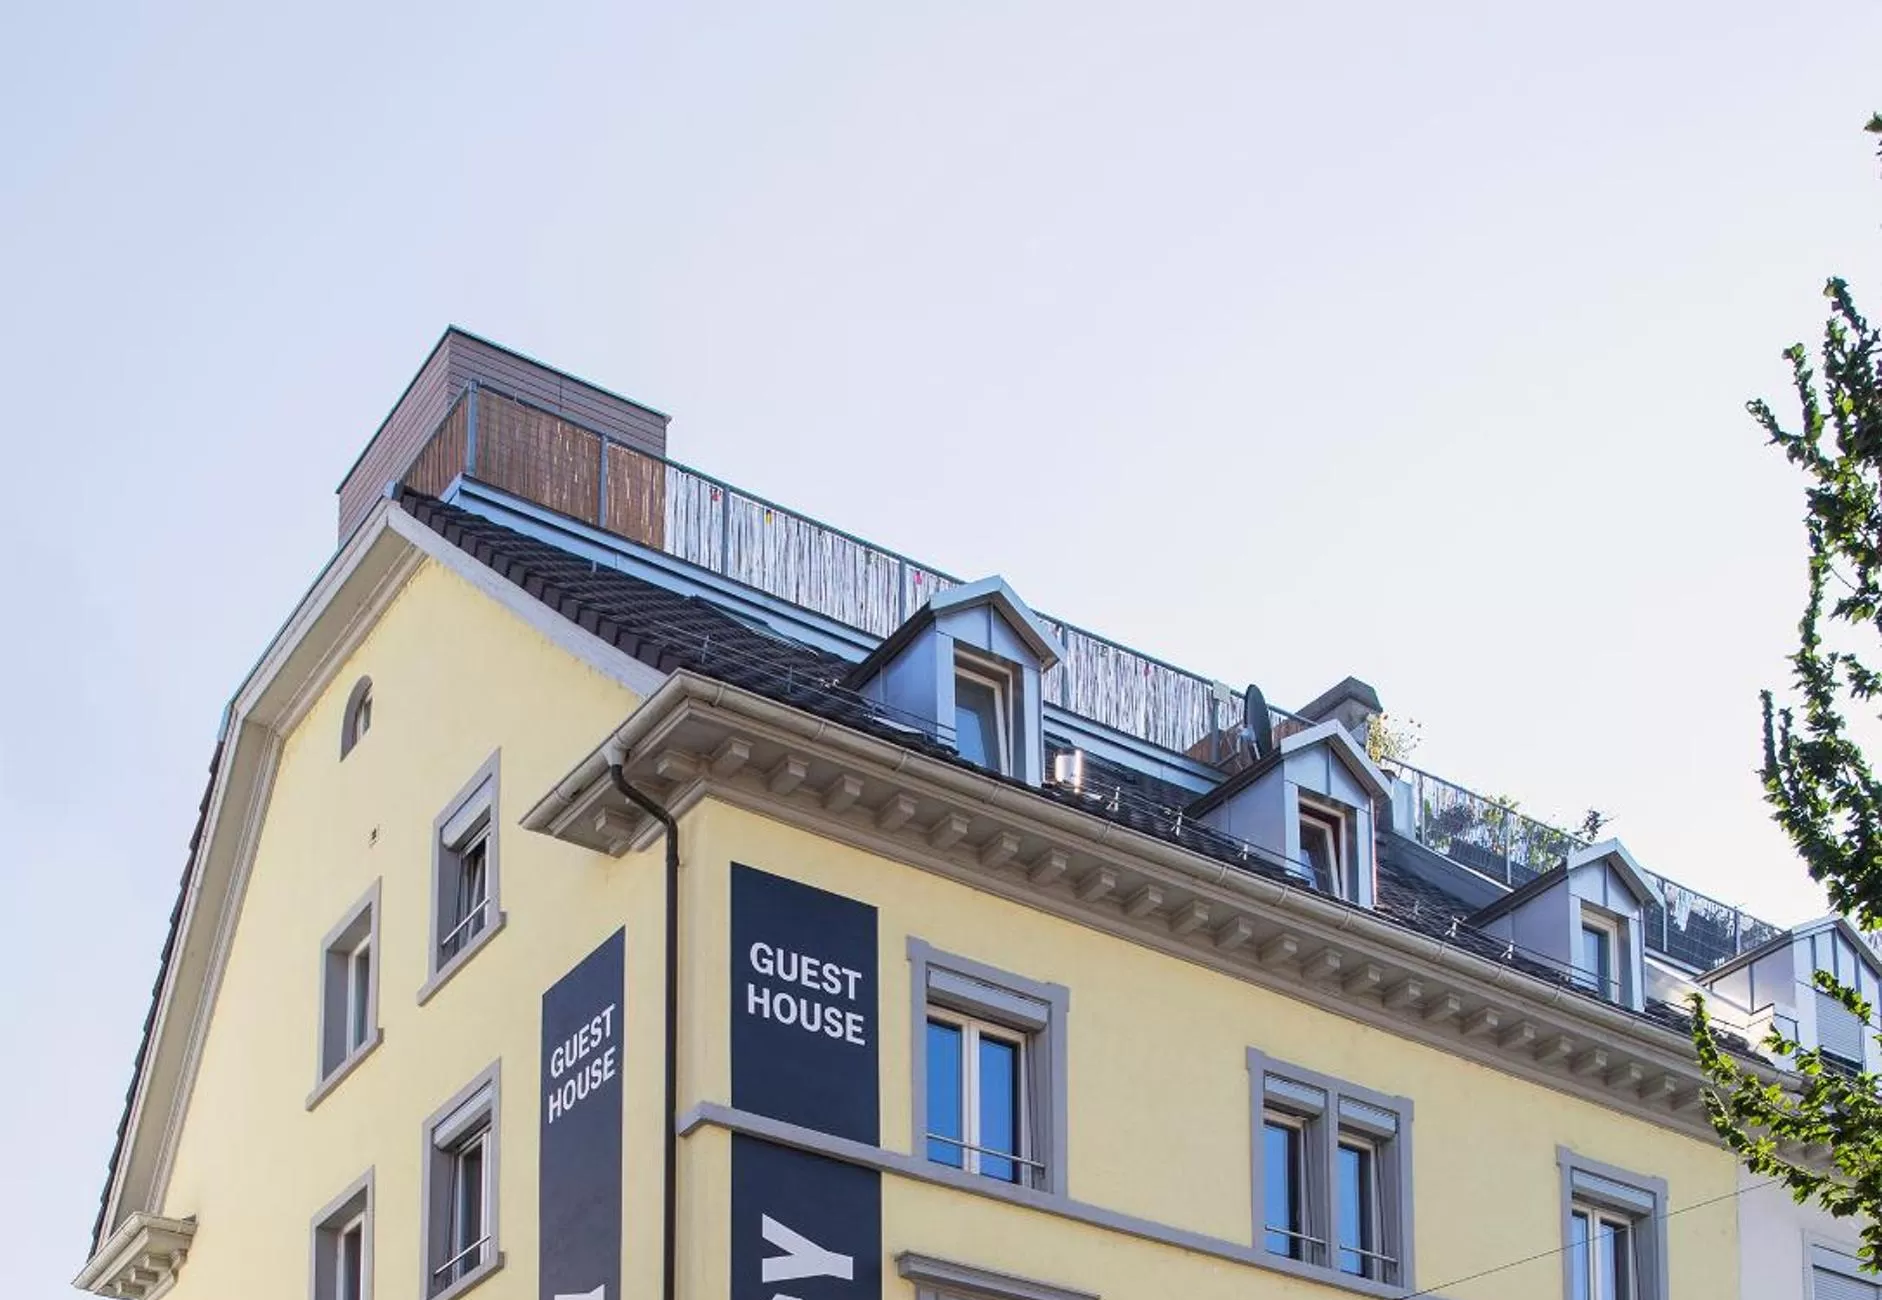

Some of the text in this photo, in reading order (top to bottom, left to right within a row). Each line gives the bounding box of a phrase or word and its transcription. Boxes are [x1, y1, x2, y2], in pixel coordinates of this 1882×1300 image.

[750, 942, 862, 1000] GUEST
[550, 1003, 615, 1079] GUEST
[747, 982, 865, 1046] HOUSE
[548, 1046, 616, 1124] HOUSE
